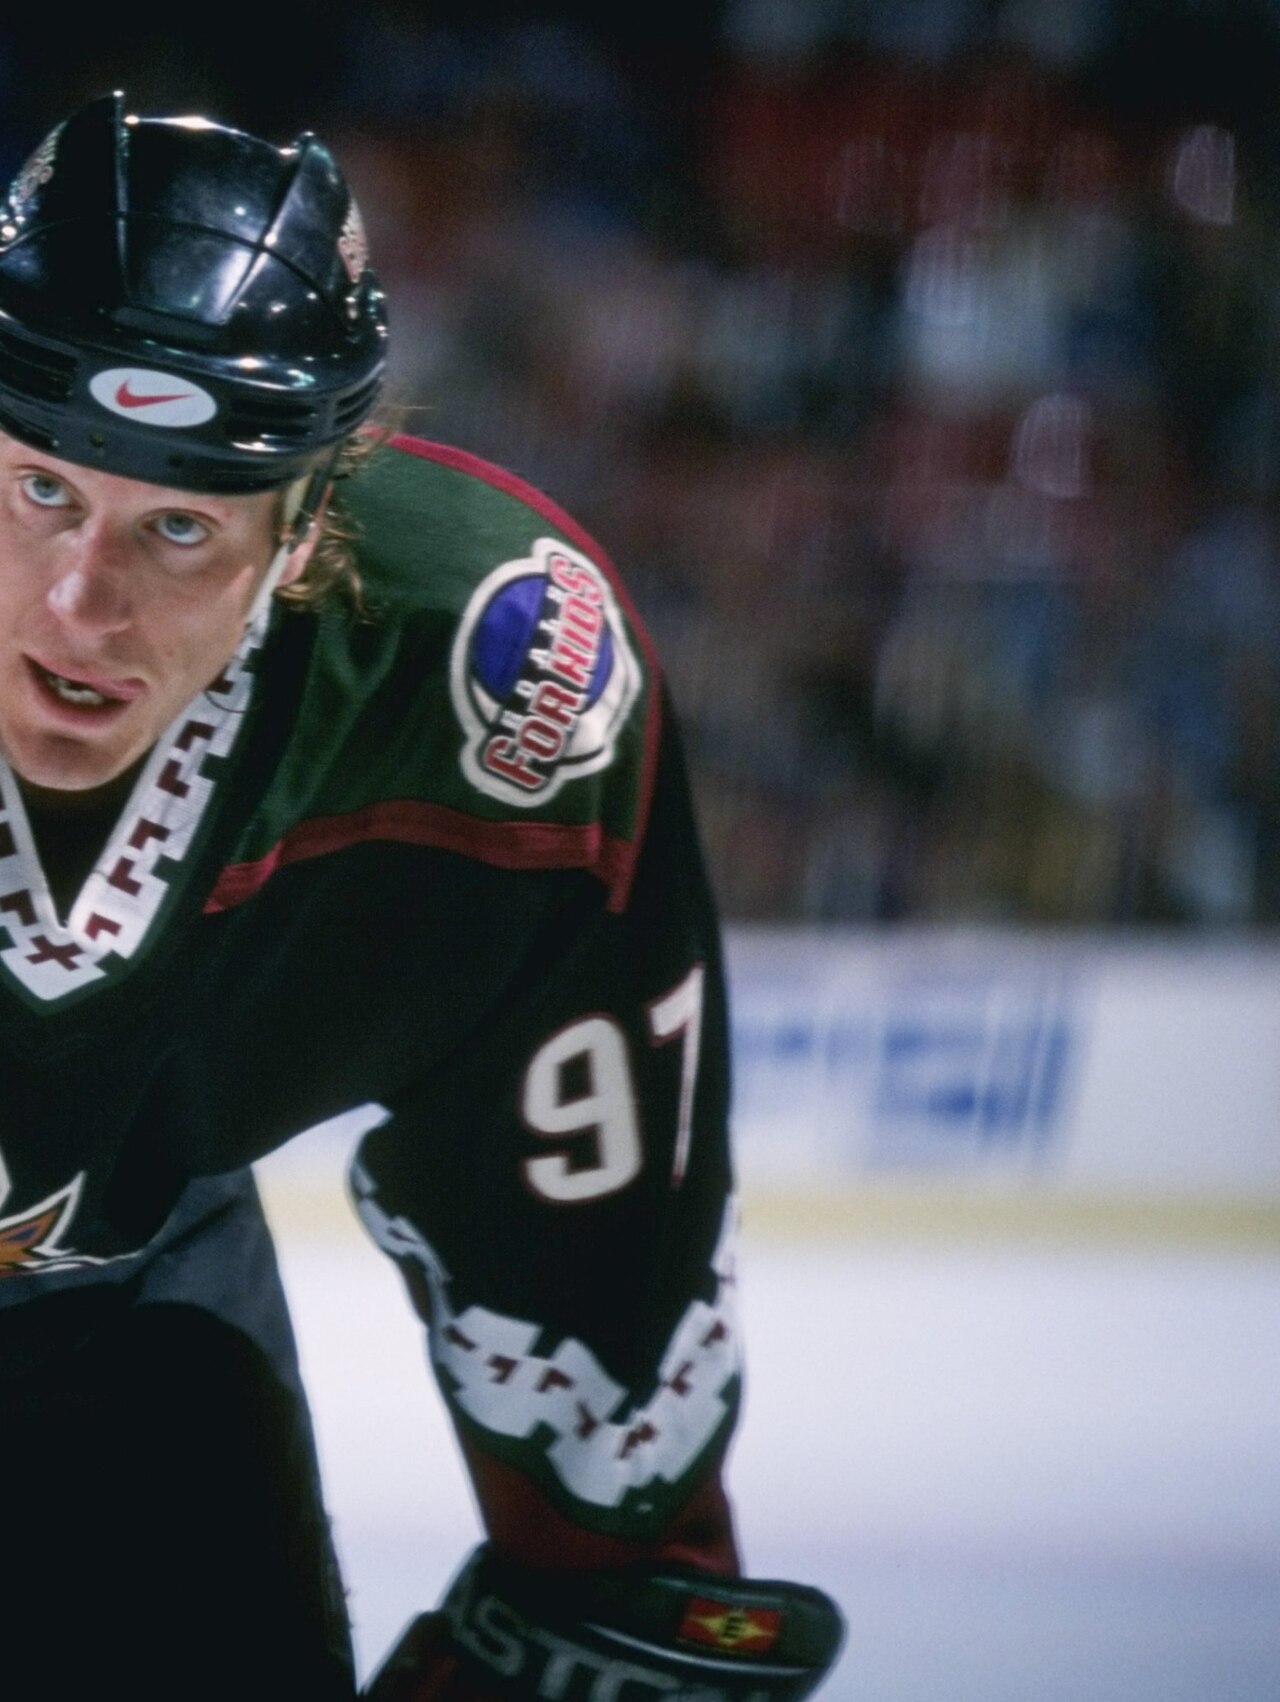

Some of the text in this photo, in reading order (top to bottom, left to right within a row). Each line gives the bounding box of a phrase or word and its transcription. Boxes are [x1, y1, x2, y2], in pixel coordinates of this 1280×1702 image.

[483, 554, 604, 789] FOR KIDS
[519, 960, 706, 1204] 97
